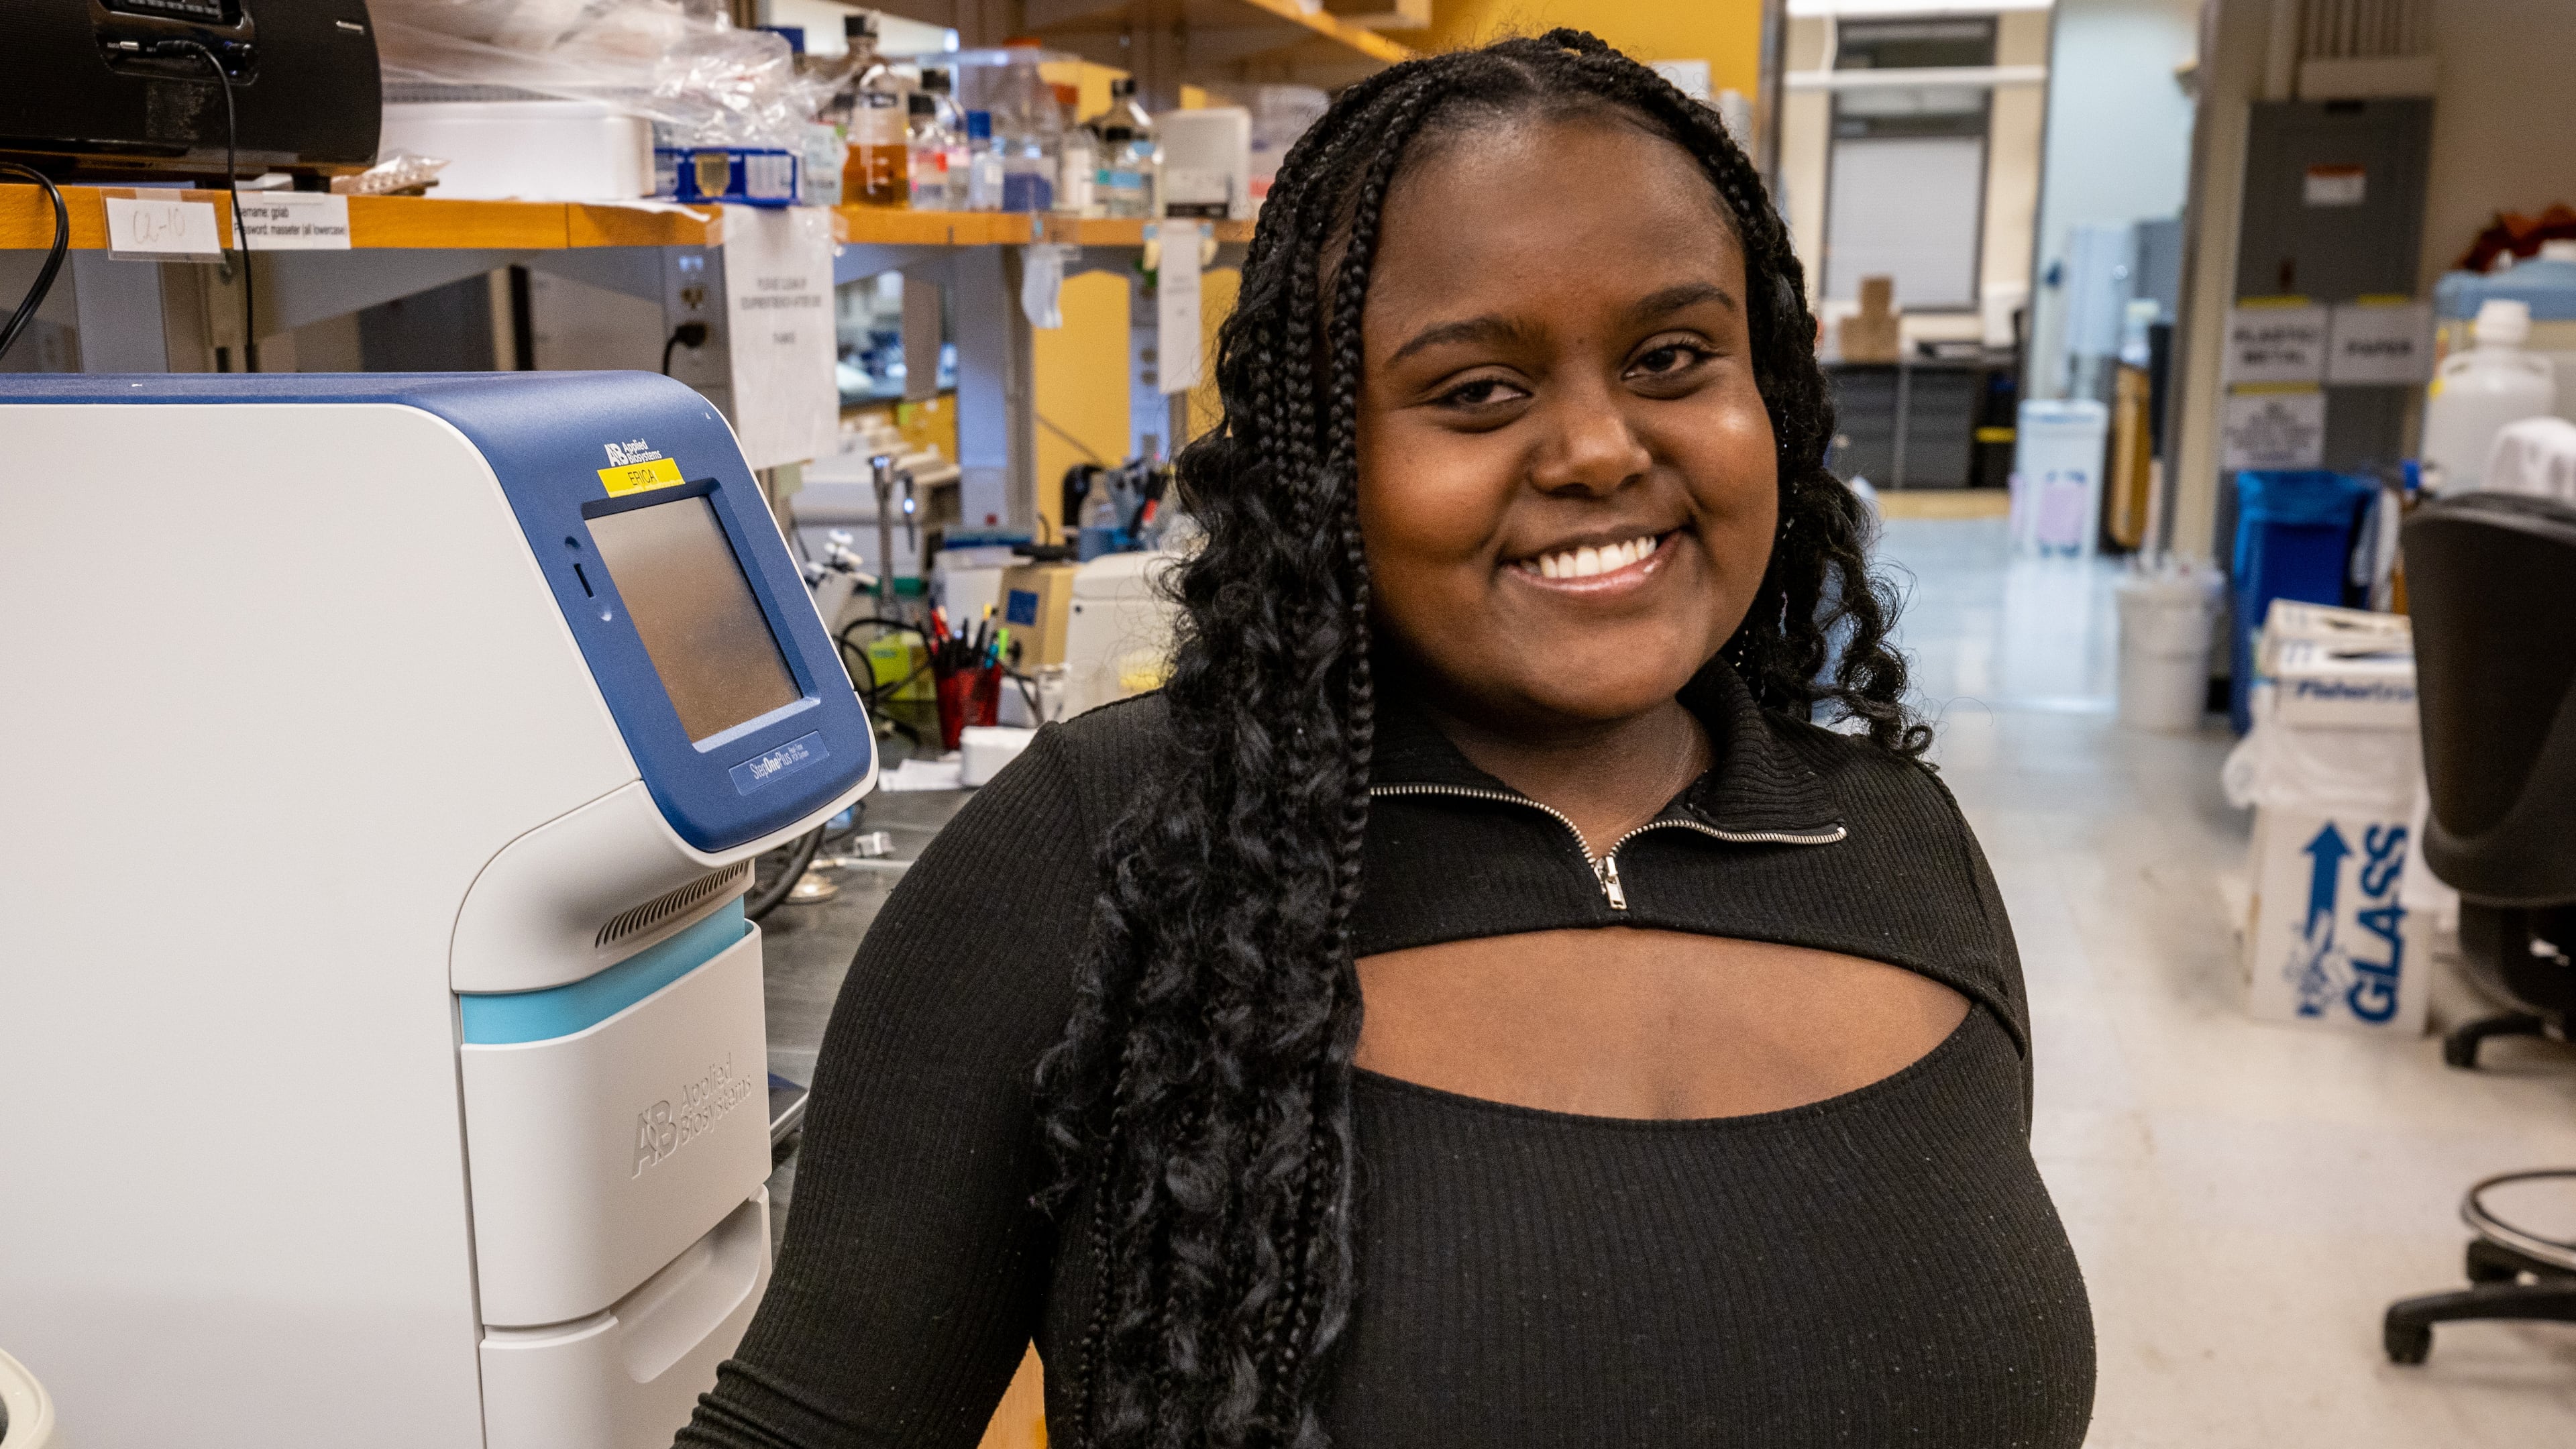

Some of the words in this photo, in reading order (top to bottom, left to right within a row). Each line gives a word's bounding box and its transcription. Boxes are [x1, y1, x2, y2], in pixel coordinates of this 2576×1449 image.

[621, 437, 649, 453] Applied
[627, 449, 663, 464] Biosystems
[627, 469, 657, 486] ERICA
[749, 751, 792, 780] StepOnePlus
[2346, 821, 2409, 1025] GLASS
[680, 1052, 733, 1118] Applied
[680, 1074, 751, 1146] Biosystems
